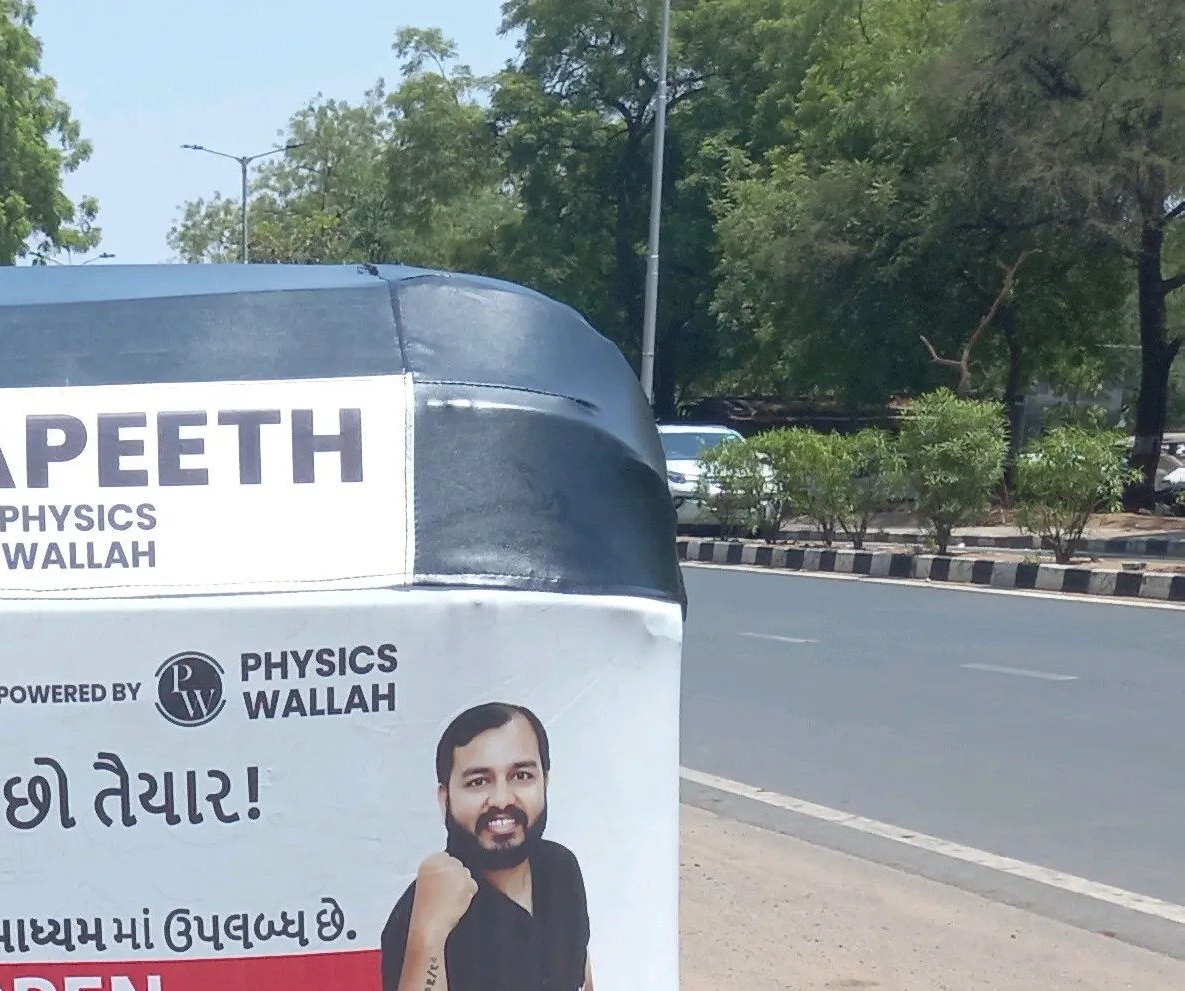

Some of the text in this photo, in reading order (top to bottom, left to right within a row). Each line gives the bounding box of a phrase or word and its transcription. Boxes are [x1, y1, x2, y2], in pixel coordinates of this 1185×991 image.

[1, 540, 157, 571] WALLAH
[241, 643, 398, 682] PHYSICS
[112, 682, 142, 702] BY
[243, 682, 396, 720] WALLAH
[2, 751, 262, 830] છો તૈયાર!
[163, 907, 308, 953] ઉપલબ્ધ
